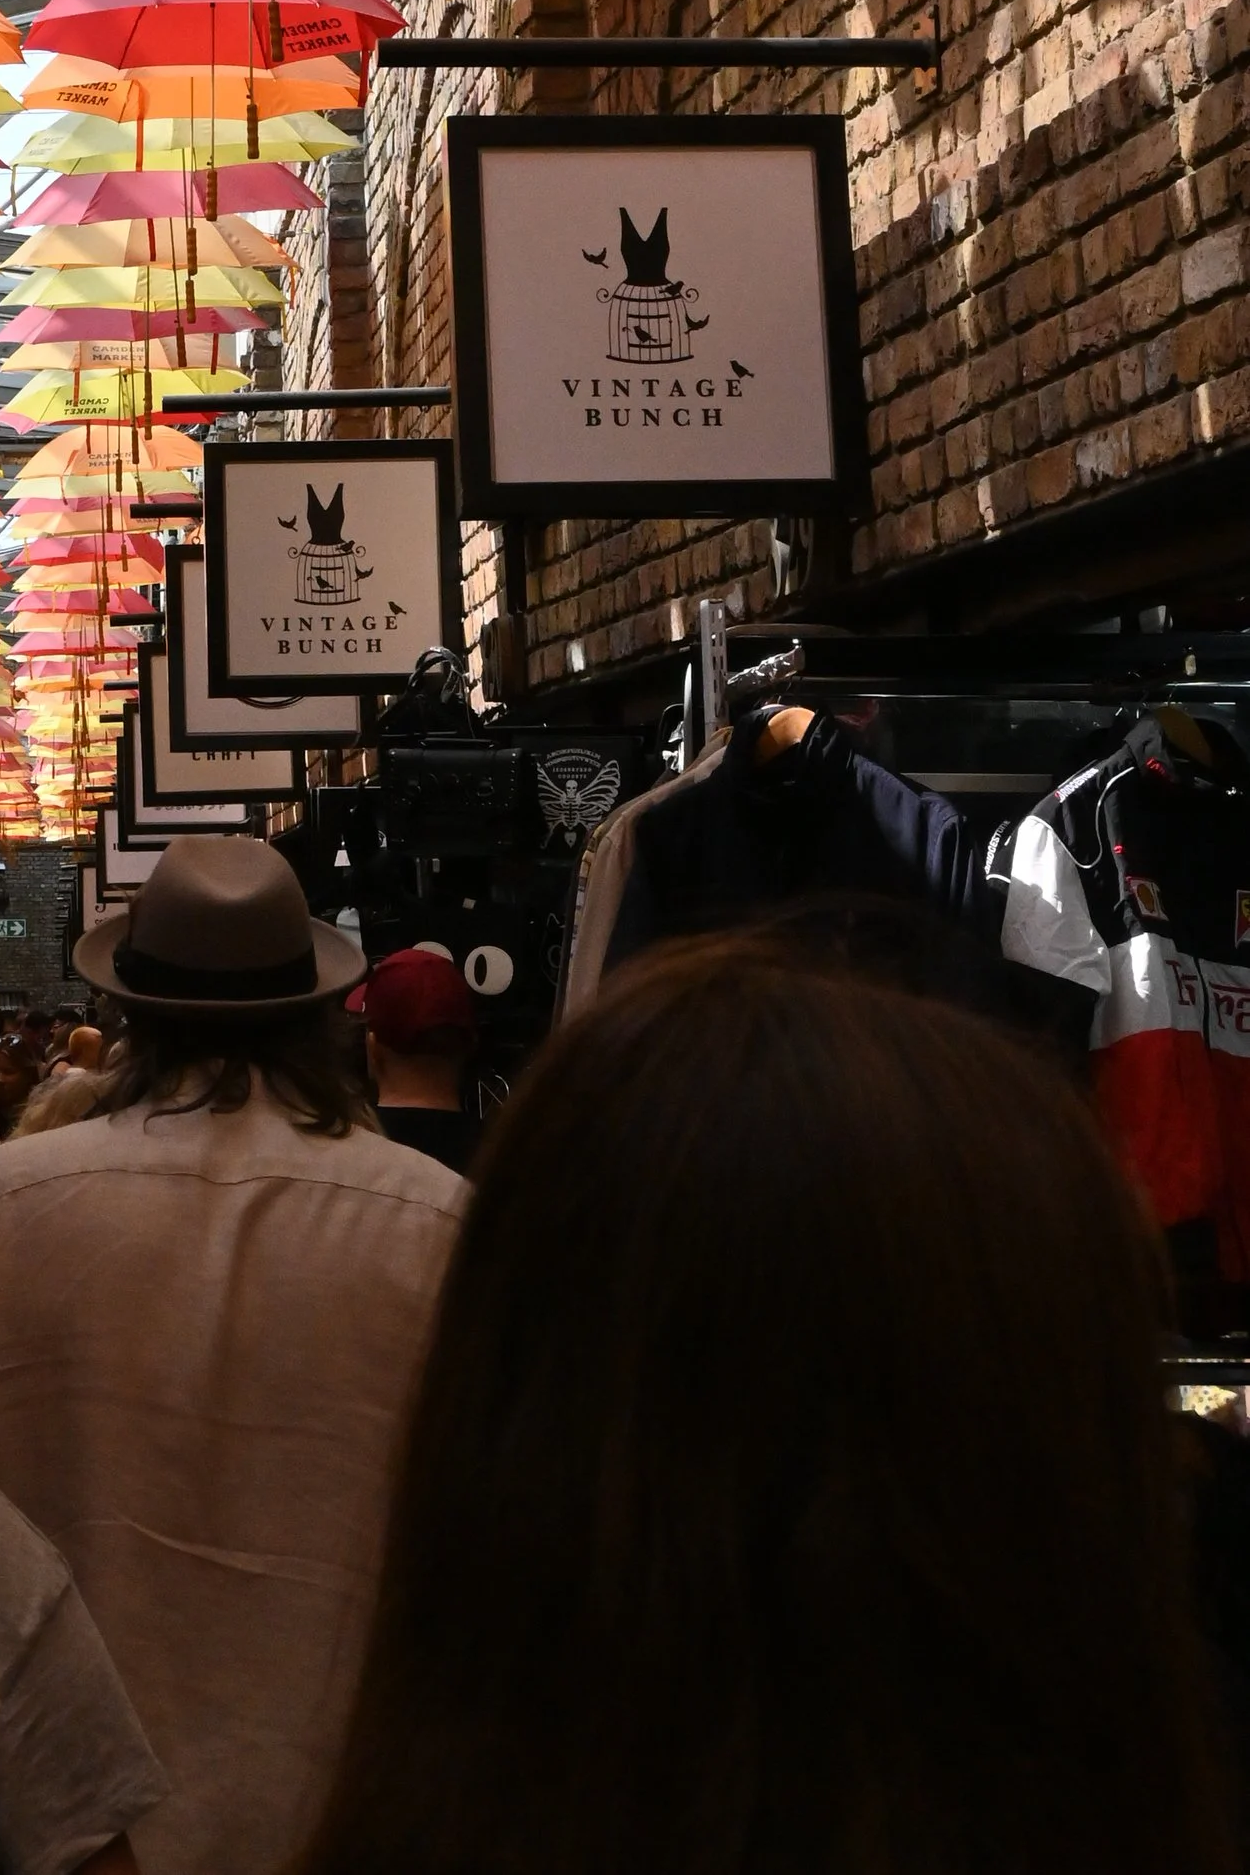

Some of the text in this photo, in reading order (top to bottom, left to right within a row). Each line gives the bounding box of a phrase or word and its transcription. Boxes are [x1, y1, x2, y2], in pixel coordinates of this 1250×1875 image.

[562, 379, 743, 397] VINTAGE
[584, 408, 723, 427] BUNCH
[260, 616, 398, 632] VINTAGE
[277, 638, 382, 655] BUNCH
